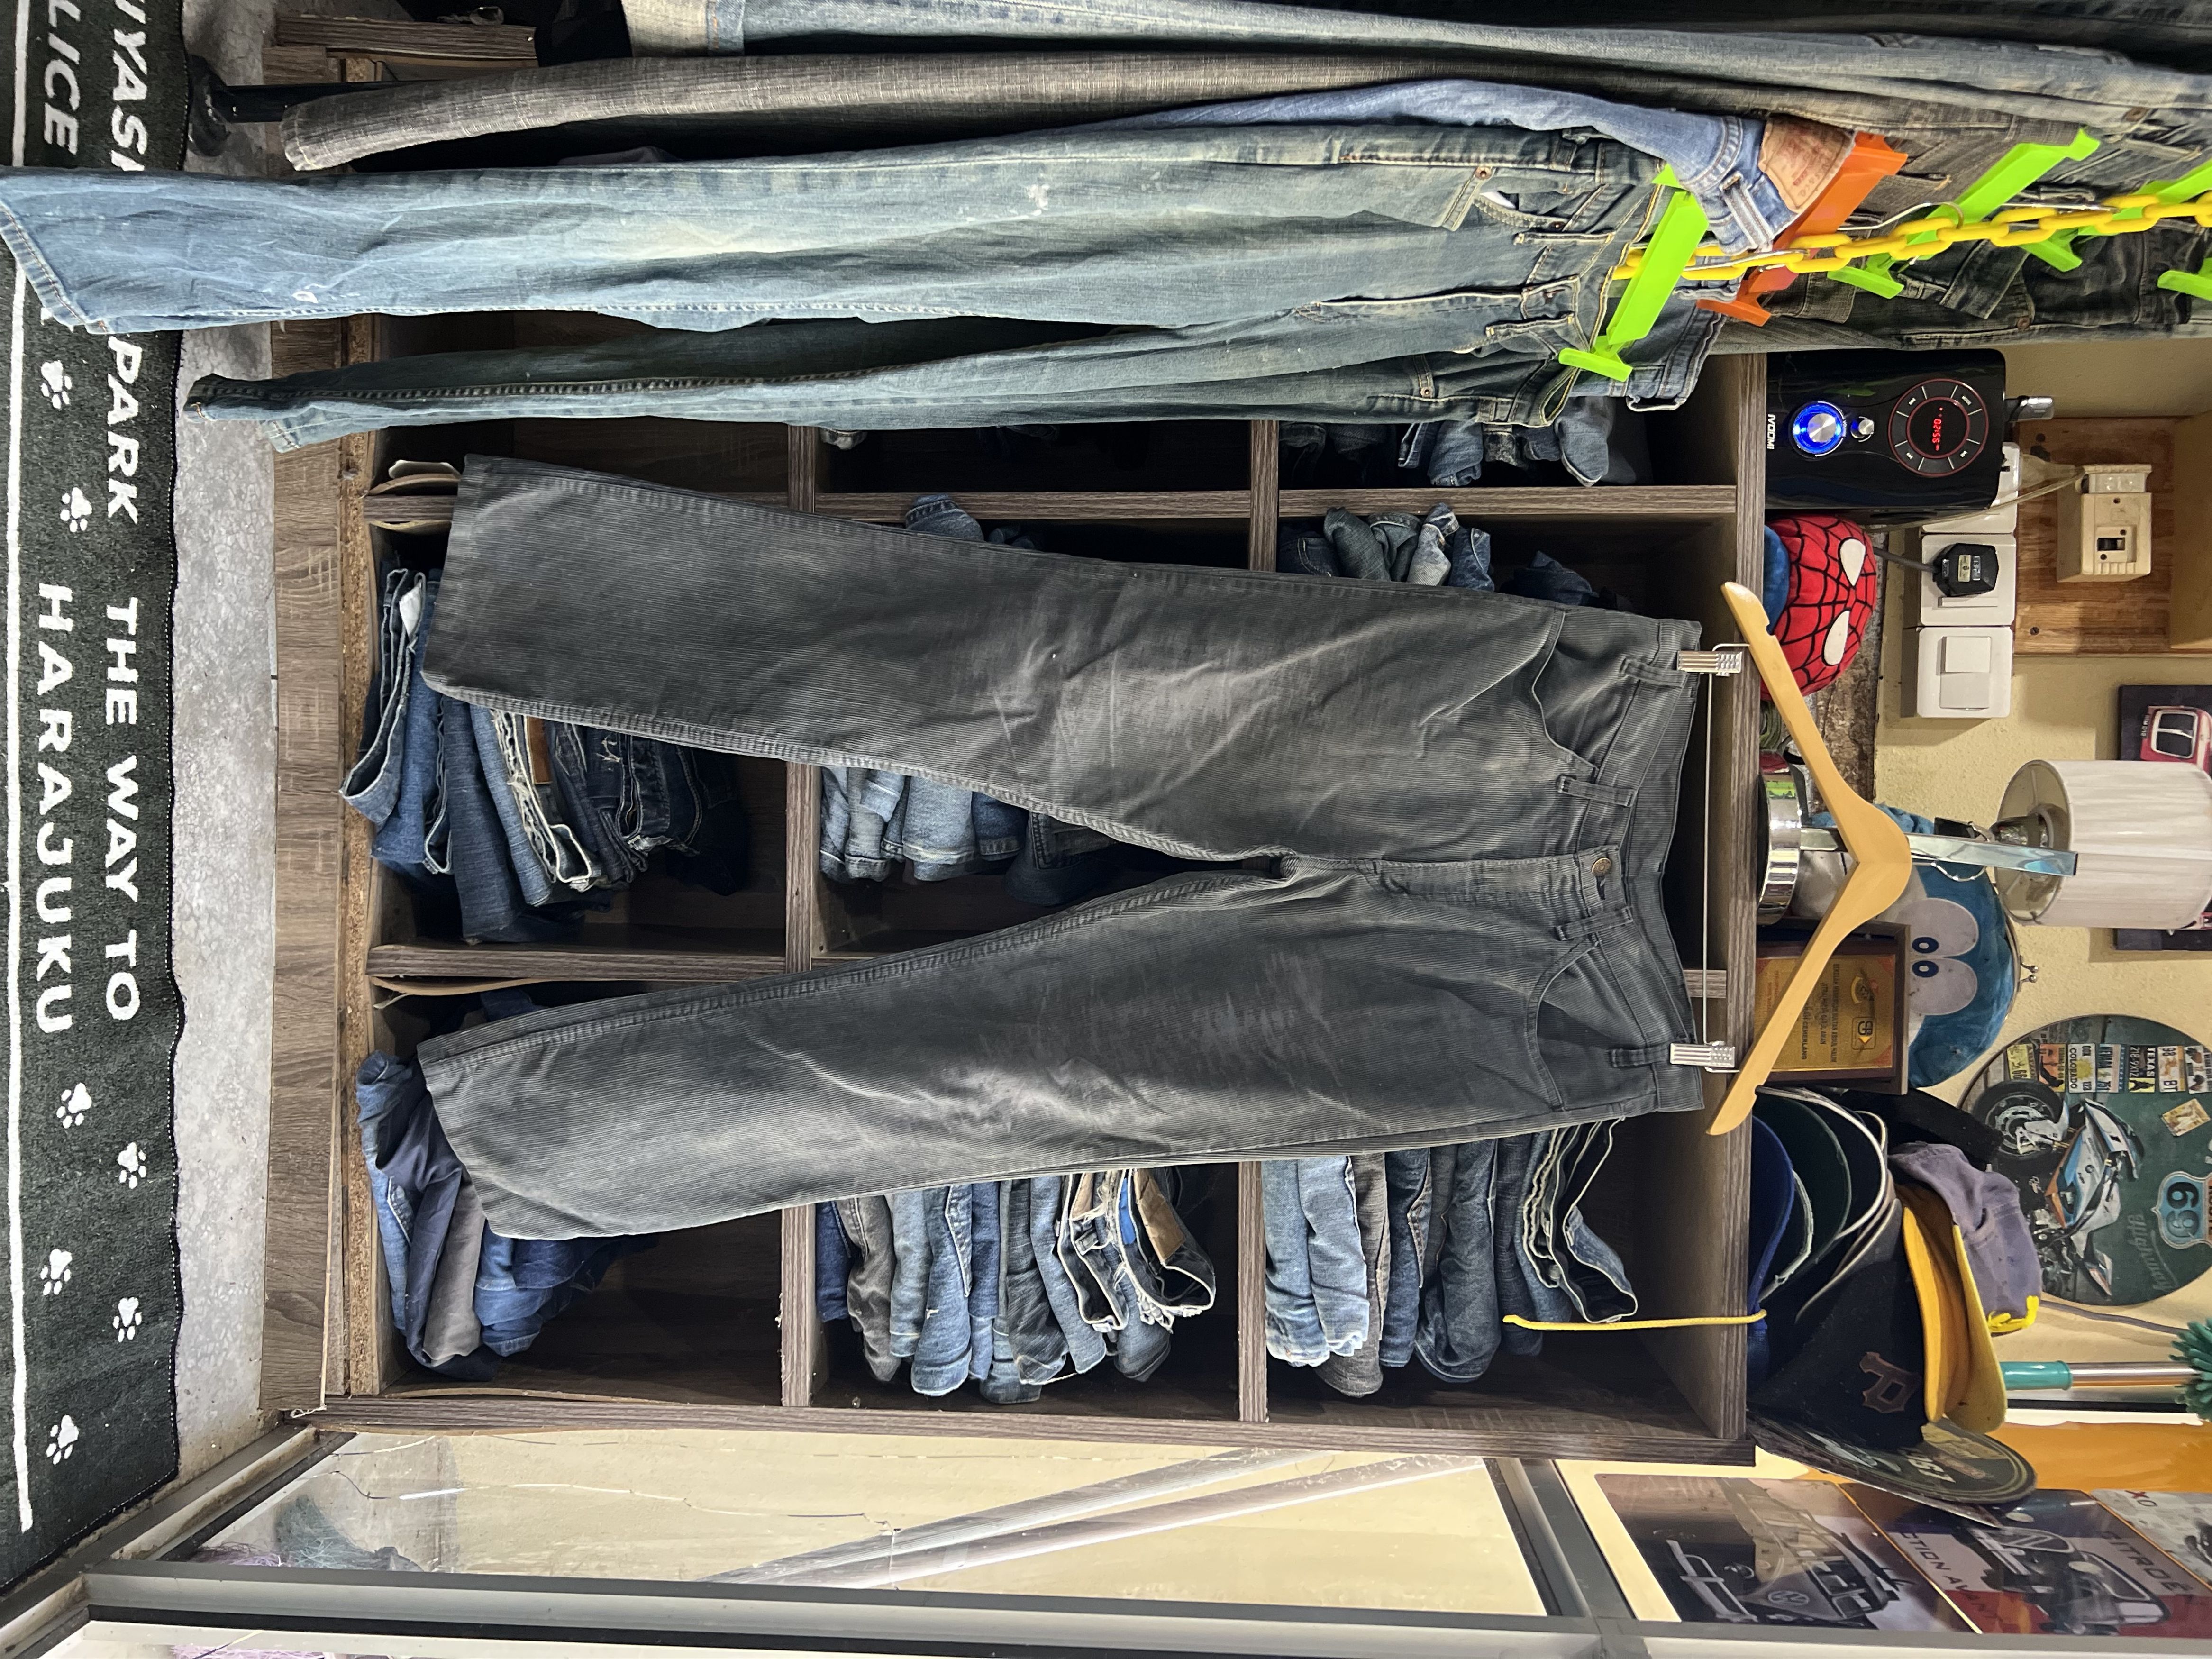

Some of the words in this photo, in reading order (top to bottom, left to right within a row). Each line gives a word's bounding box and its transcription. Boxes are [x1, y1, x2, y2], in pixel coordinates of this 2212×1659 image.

[111, 0, 147, 171] IYAS
[107, 336, 143, 524] PARK
[106, 597, 139, 725] THE
[36, 583, 74, 1033] HARAJUKU
[105, 755, 139, 902] WAY
[105, 930, 140, 1020] TO
[2146, 1048, 2156, 1076] TEXAS
[2162, 1048, 2176, 1056] 98
[2163, 1080, 2178, 1091] BT
[2166, 1182, 2200, 1238] 69
